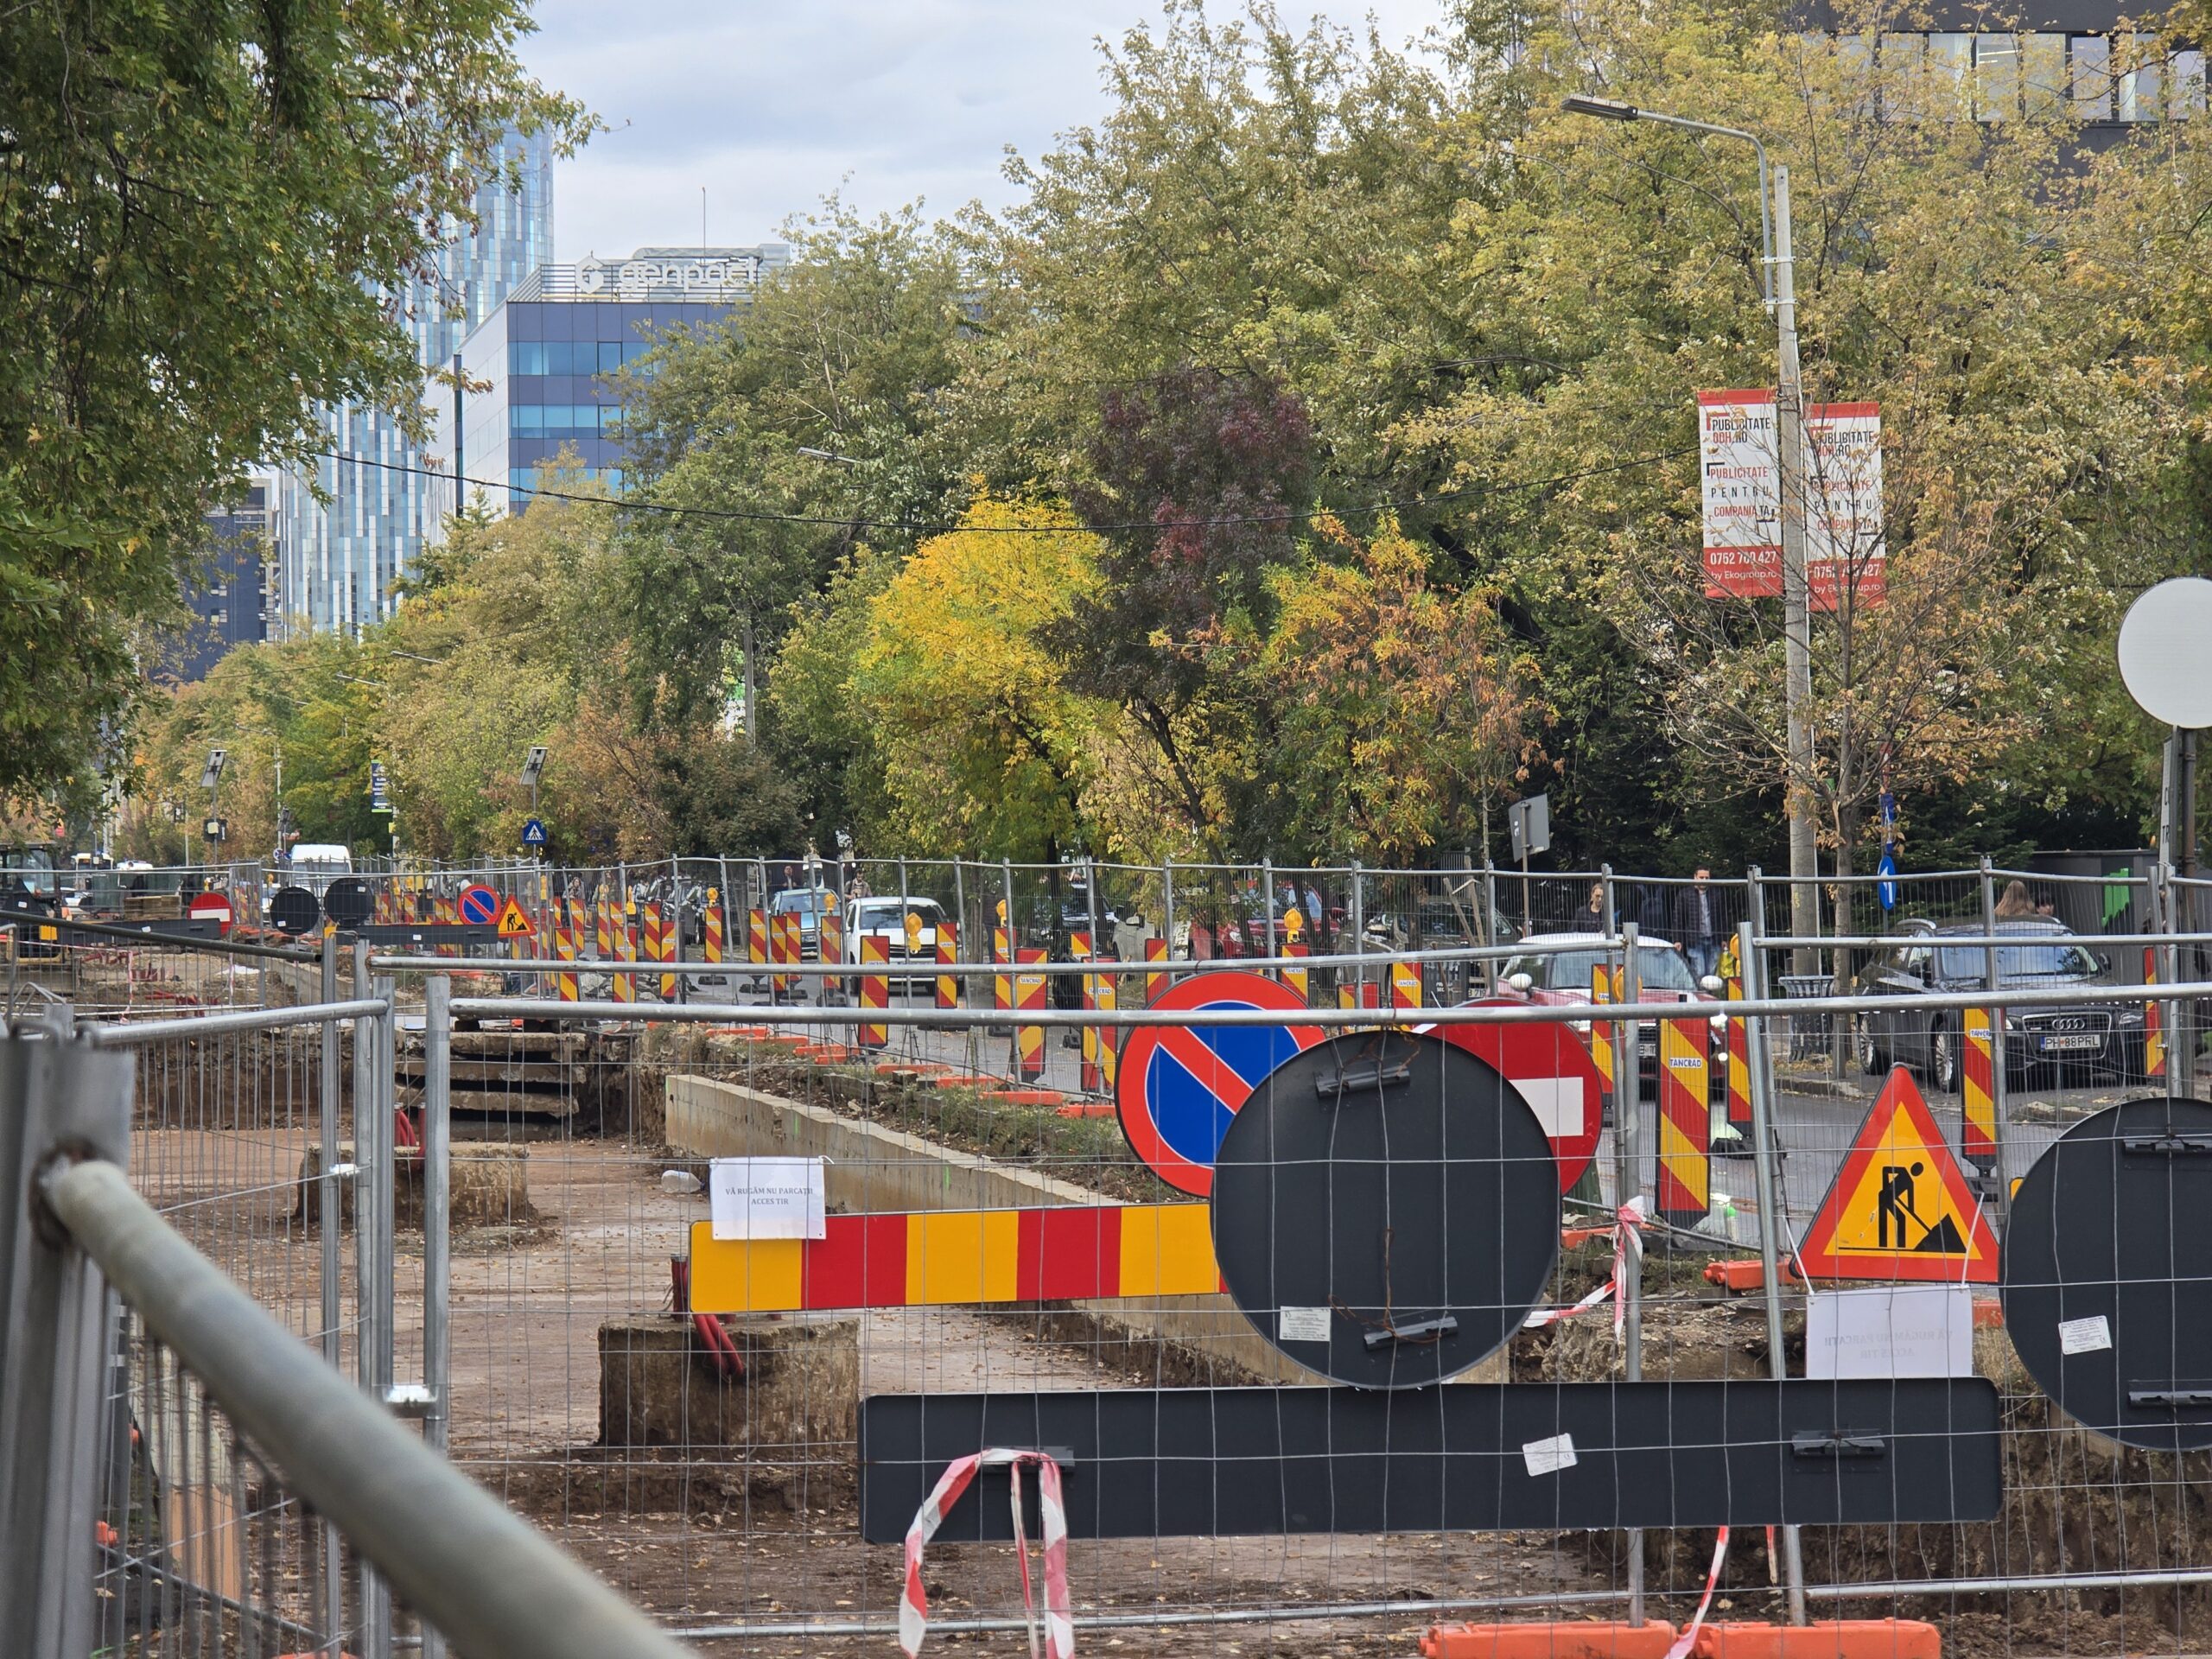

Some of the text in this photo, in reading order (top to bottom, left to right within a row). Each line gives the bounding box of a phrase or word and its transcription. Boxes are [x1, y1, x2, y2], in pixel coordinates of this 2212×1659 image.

[619, 256, 758, 293] genpact
[1816, 430, 1874, 444] UBLICITATE
[1710, 466, 1769, 480] PUBLICITATE
[1711, 485, 1770, 499] PENTRU
[1815, 499, 1872, 512] PNTRU
[1758, 550, 1777, 564] 427
[1711, 570, 1777, 582] by Ekogroup.ro
[1814, 584, 1826, 595] by
[1669, 1058, 1701, 1067] TANCRAD
